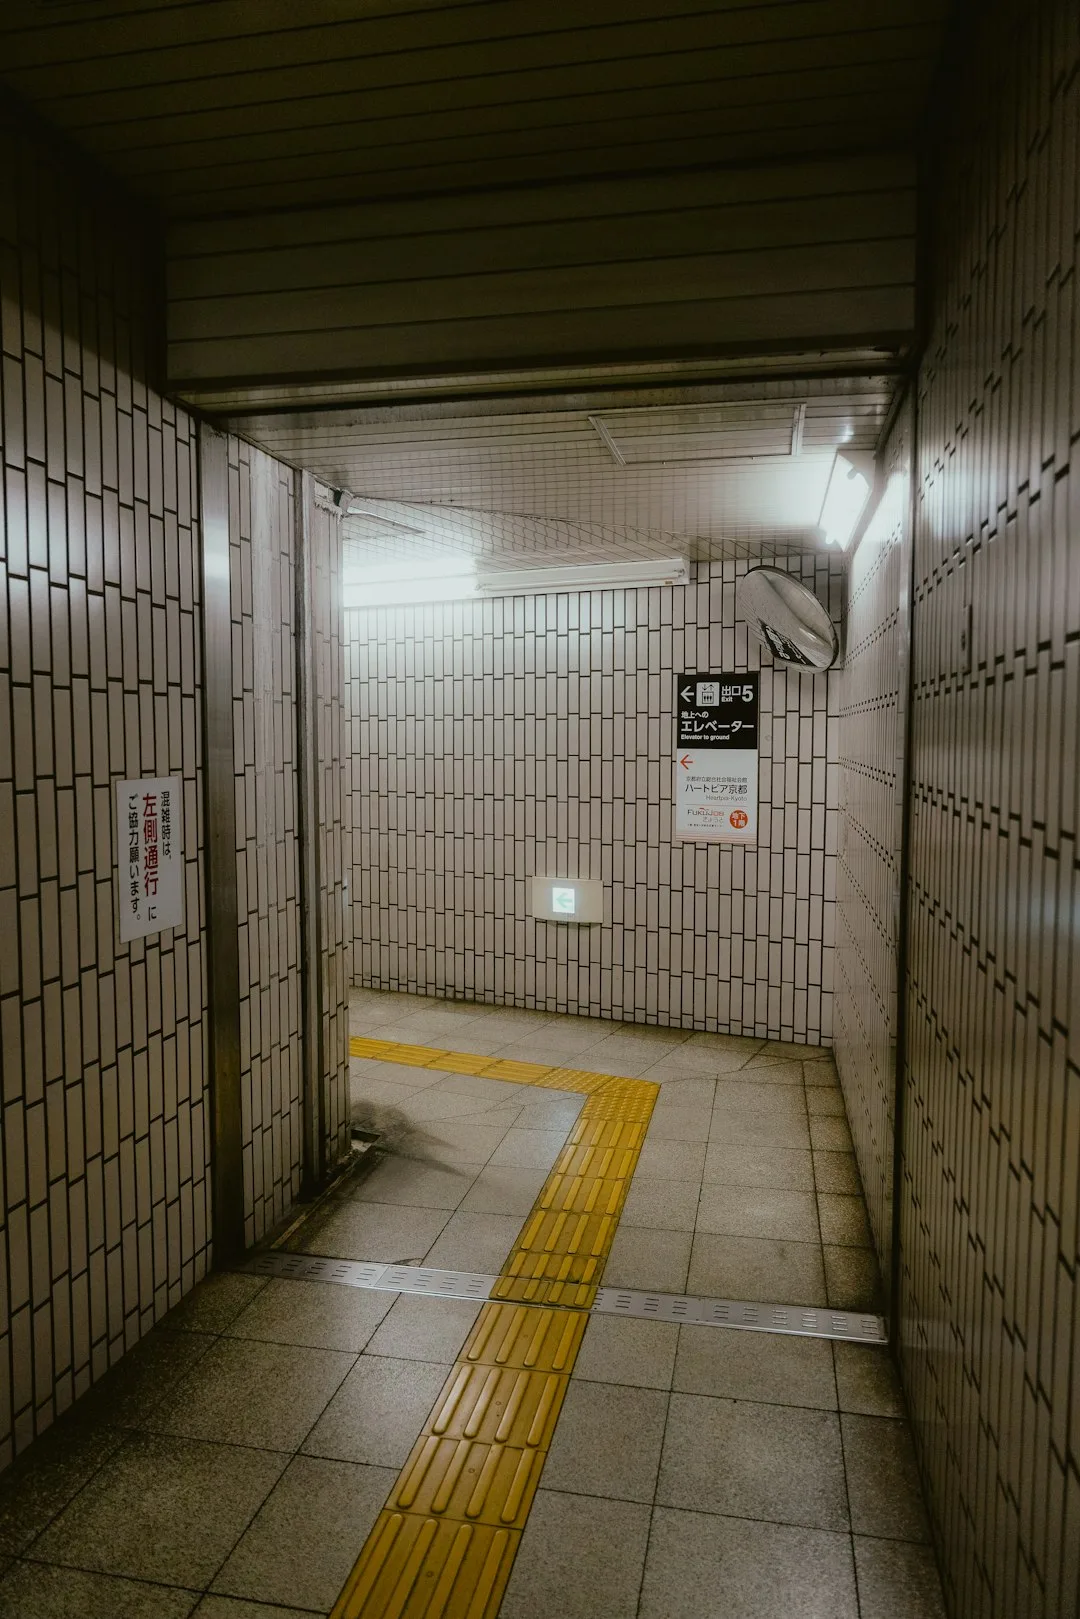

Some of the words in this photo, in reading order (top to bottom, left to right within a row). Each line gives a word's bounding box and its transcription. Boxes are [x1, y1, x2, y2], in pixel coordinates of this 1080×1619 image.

[721, 685, 741, 696] 出口
[741, 685, 754, 702] 5
[680, 711, 709, 719] 地上への
[680, 720, 755, 733] エレベーター
[685, 784, 748, 794] ハートピア京都
[128, 793, 142, 921] ご協力願います。
